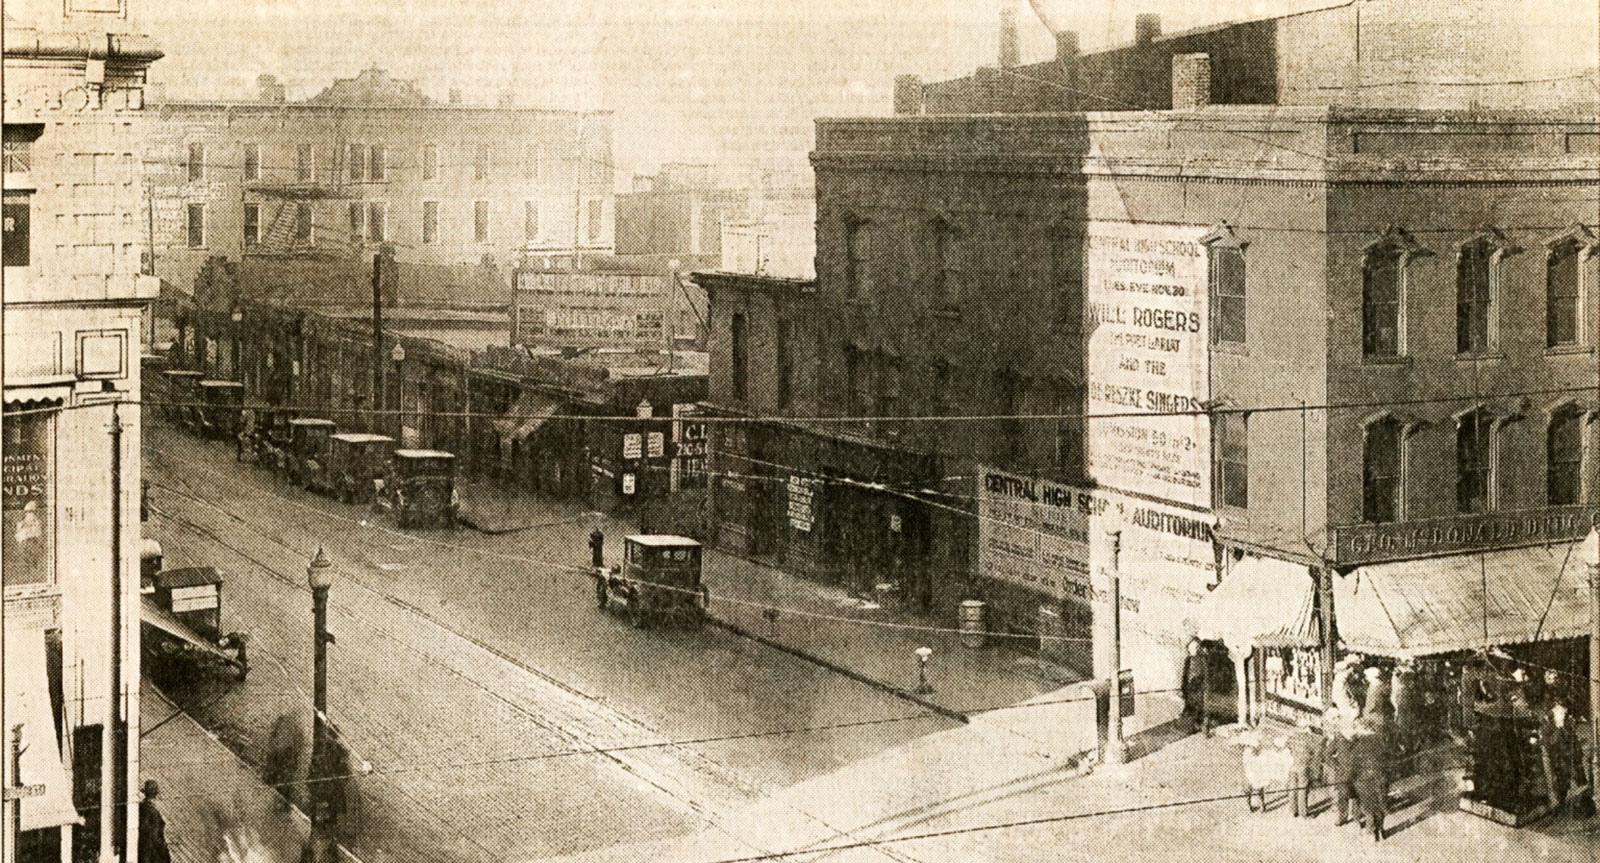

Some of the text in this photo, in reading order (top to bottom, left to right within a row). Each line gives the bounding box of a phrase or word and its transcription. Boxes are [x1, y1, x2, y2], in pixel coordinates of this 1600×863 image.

[1159, 239, 1201, 257] SCHOOL
[1090, 302, 1201, 333] WILL ROGERS
[1118, 352, 1167, 375] AND THE
[984, 472, 1038, 503] CENTRAL
[1043, 485, 1071, 508] HIGH
